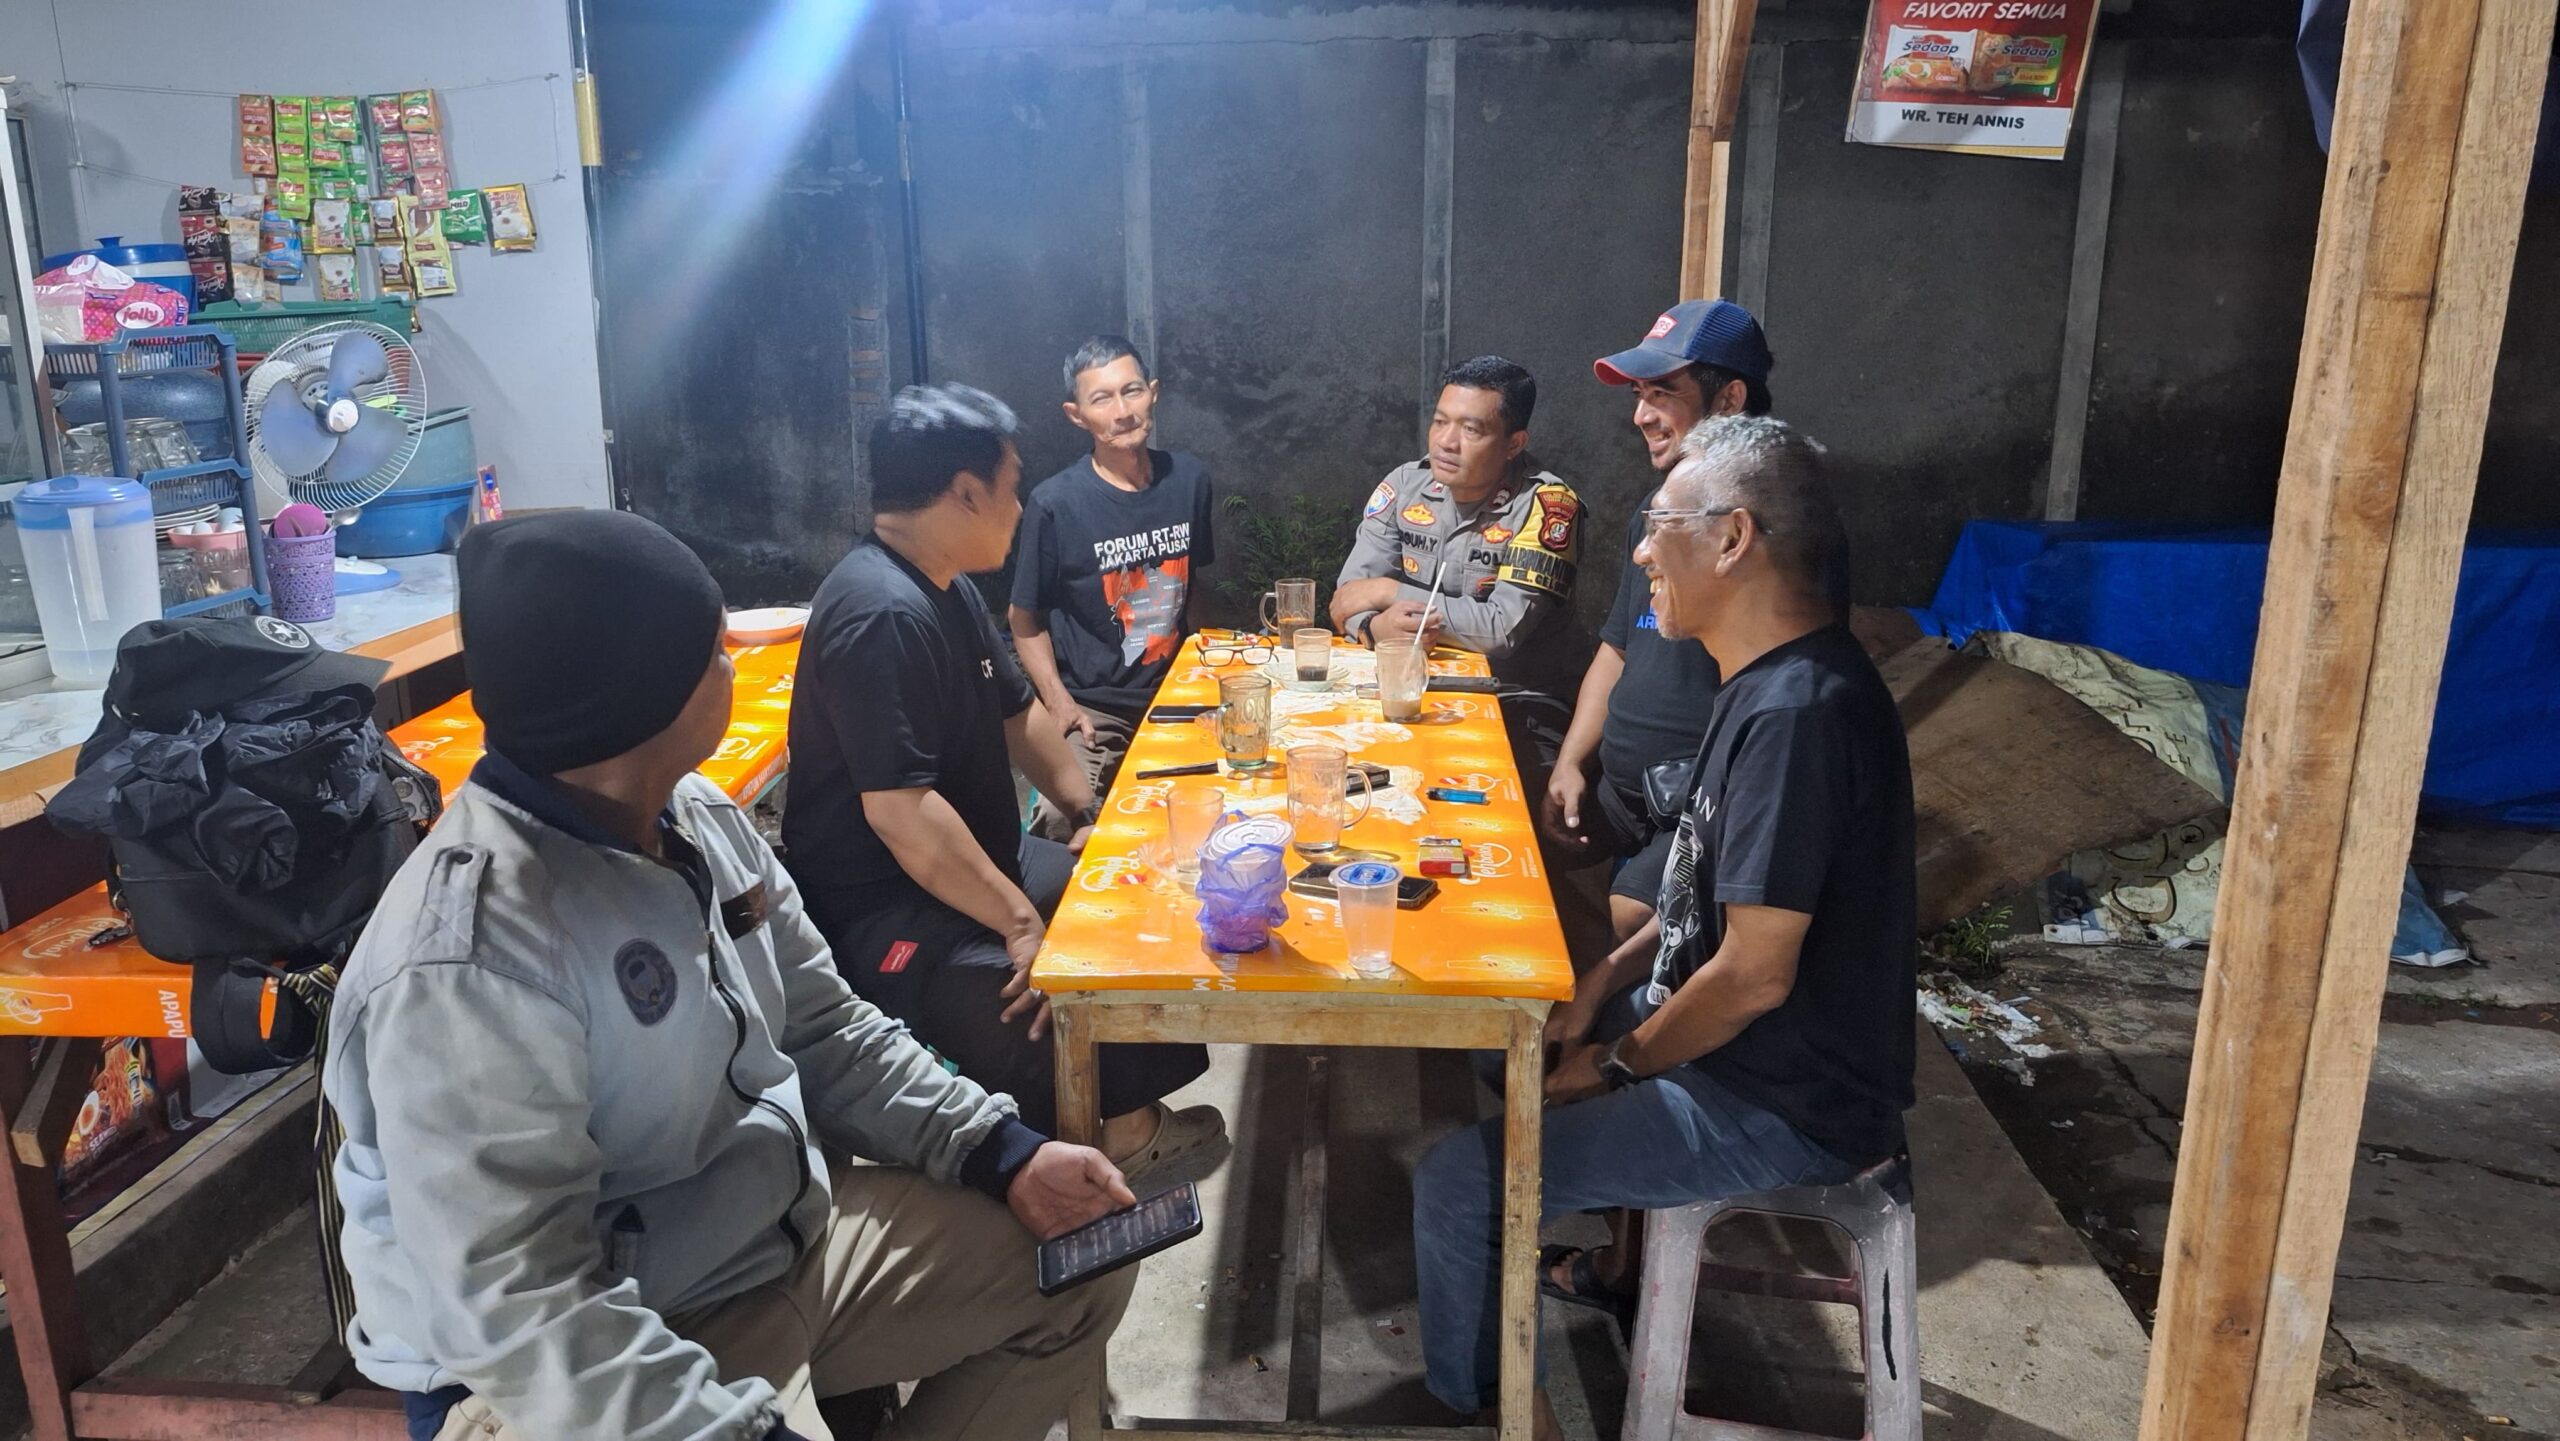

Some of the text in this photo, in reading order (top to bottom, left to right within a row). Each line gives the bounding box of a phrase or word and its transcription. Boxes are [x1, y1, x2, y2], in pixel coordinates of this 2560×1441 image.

[1902, 1, 2067, 20] FAVORIT SEMUA
[1902, 40, 1960, 55] Sedaap
[2002, 43, 2059, 59] Sedaap
[1901, 108, 2025, 129] WR. TEH ANNIS
[122, 307, 158, 322] jolly
[1093, 521, 1190, 558] FORUM RT-RW
[1099, 537, 1191, 571] JAKARTA PUSAT
